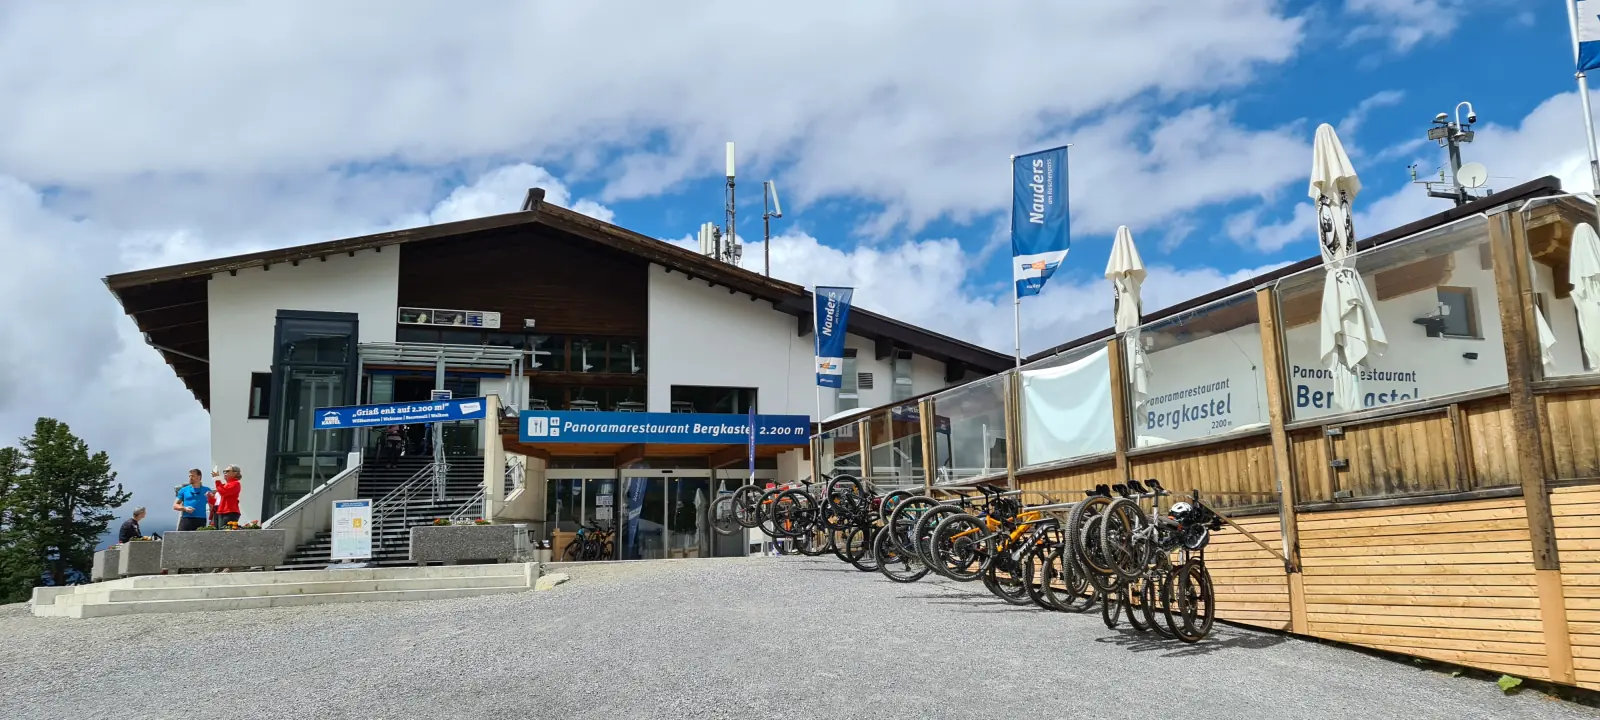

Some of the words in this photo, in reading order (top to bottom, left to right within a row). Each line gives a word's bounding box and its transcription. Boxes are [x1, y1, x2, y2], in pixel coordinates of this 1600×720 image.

[1030, 159, 1044, 225] Nauders
[822, 291, 836, 337] Nauders
[380, 405, 395, 415] enk
[397, 404, 410, 414] auf
[412, 404, 432, 412] 2.200
[1147, 391, 1232, 430] Bergkastel
[563, 421, 689, 434] Panoramarestaurant
[693, 423, 750, 436] Bergkaste
[759, 426, 791, 435] 2.200
[794, 427, 804, 435] m
[1211, 418, 1227, 429] 2200
